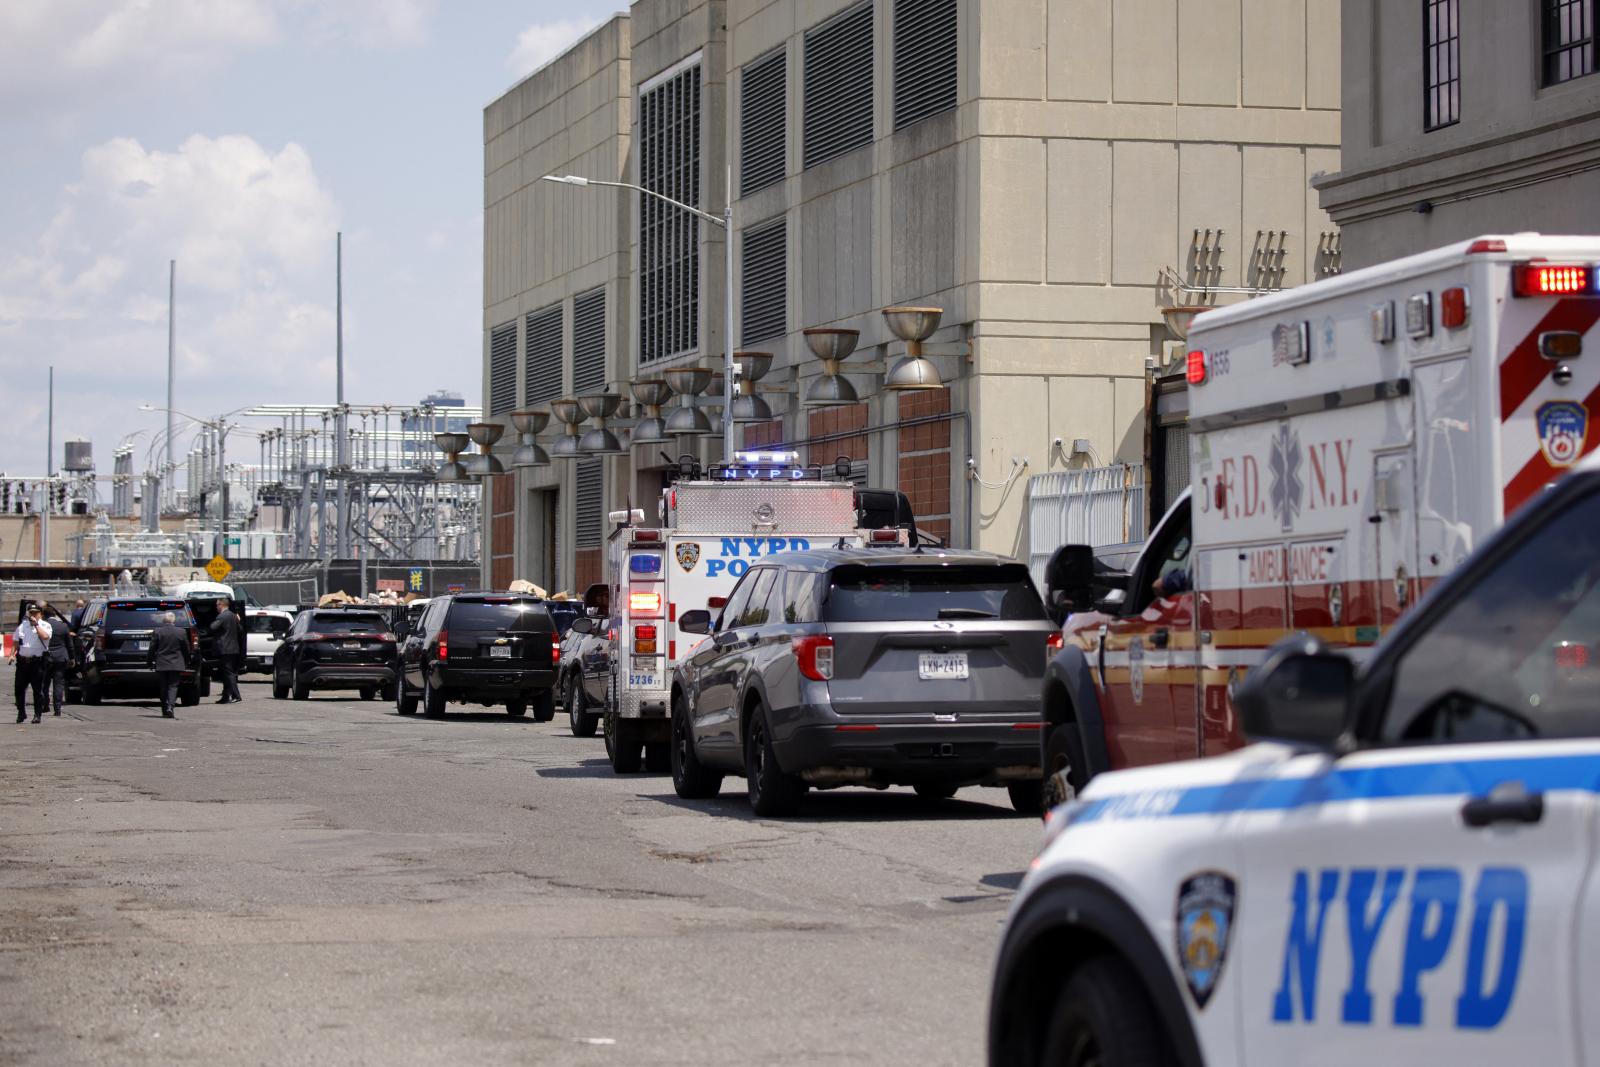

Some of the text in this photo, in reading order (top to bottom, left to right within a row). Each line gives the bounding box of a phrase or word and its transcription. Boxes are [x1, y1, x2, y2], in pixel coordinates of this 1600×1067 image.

[725, 469, 804, 479] NYPD
[720, 537, 810, 556] NYPD
[706, 559, 756, 577] PO
[1249, 546, 1328, 584] AMBULANCE
[629, 674, 653, 685] 5736
[1272, 866, 1530, 1030] NYPD
